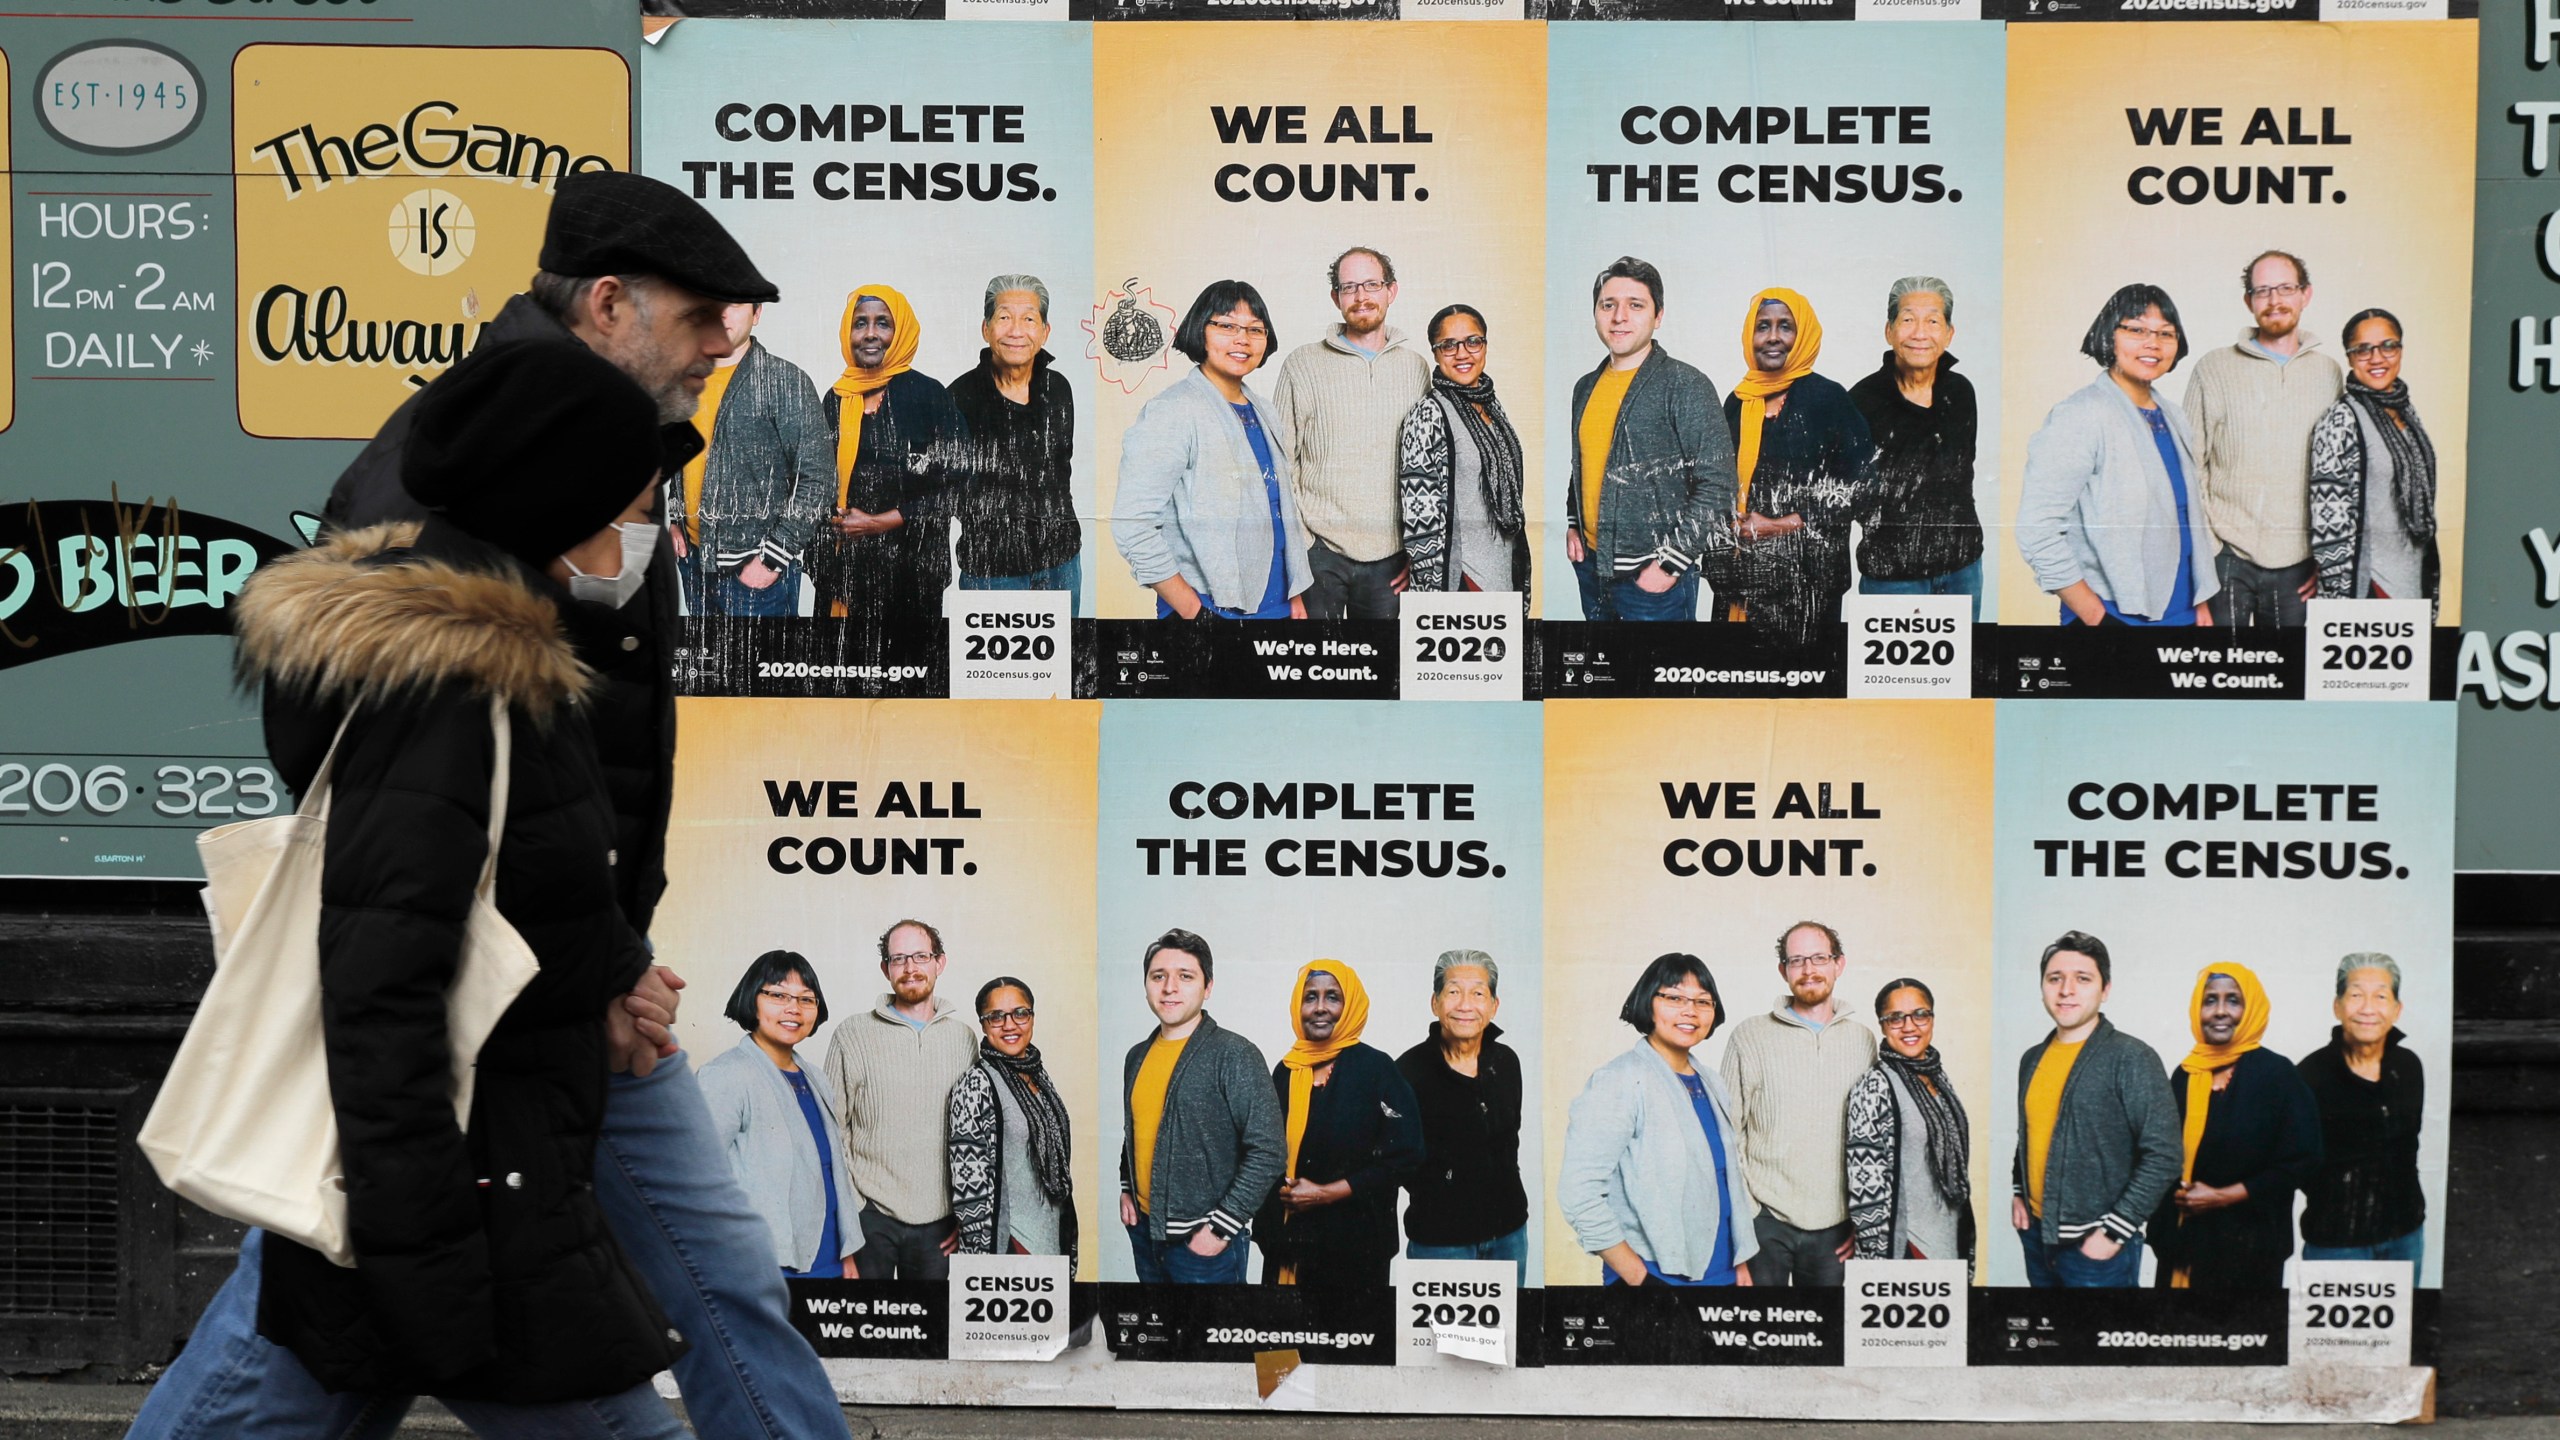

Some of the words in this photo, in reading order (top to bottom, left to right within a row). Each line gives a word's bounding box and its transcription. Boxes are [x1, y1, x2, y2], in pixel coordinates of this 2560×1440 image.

[2338, 0, 2426, 10] 2020census.gov
[715, 103, 1024, 142] COMPLETE
[1210, 106, 1306, 143] WE
[1324, 106, 1432, 143] ALL
[1621, 106, 1930, 144] COMPLETE
[2126, 108, 2222, 145] WE
[2241, 107, 2351, 145] ALL
[682, 161, 794, 199] THE
[813, 162, 1056, 201] CENSUS.
[1215, 164, 1428, 202] COUNT.
[1587, 165, 1698, 202] THE
[1718, 164, 1962, 203] CENSUS.
[2128, 166, 2346, 205] COUNT.
[41, 202, 208, 240] HOURS:
[58, 533, 258, 613] BEER
[966, 613, 1055, 628] CENSUS
[1416, 615, 1506, 630] CENSUS
[1865, 618, 1955, 633] CENSUS
[2324, 623, 2413, 637] CENSUS
[965, 635, 1054, 660] 2020
[1254, 640, 1316, 655] We’re
[1322, 640, 1378, 656] Here.
[1416, 637, 1506, 662] 2020
[1864, 640, 1954, 665] 2020
[2157, 647, 2221, 663] We’re
[2227, 648, 2284, 663] Here.
[2323, 645, 2412, 670] 2020
[758, 661, 928, 685] 2020census.gov
[967, 671, 1051, 680] 2020census.gov
[1267, 666, 1302, 680] We
[1308, 665, 1377, 680] Count.
[1417, 673, 1502, 682] 2020census.gov
[1655, 667, 1825, 686] 2020census.gov
[1865, 676, 1951, 685] 2020census.gov
[2171, 673, 2207, 688] We
[2211, 672, 2284, 688] Count.
[2323, 680, 2409, 690] 2020census.gov
[763, 781, 858, 817] WE
[875, 782, 981, 818] ALL
[1170, 782, 1474, 820] COMPLETE
[1660, 782, 1755, 819] WE
[1772, 782, 1880, 819] ALL
[2068, 782, 2377, 821] COMPLETE
[768, 837, 977, 875] COUNT.
[1137, 839, 1246, 875] THE
[1265, 839, 1506, 878] CENSUS.
[1663, 839, 1876, 876] COUNT.
[2034, 840, 2145, 877] THE
[2165, 840, 2409, 879] CENSUS.
[966, 1277, 1053, 1292] CENSUS
[1413, 1282, 1501, 1297] CENSUS
[1862, 1283, 1950, 1297] CENSUS
[2309, 1284, 2395, 1297] CENSUS
[807, 1299, 867, 1314] We’re
[874, 1300, 927, 1315] Here.
[965, 1298, 1053, 1323] 2020
[1411, 1303, 1501, 1329] 2020
[1699, 1306, 1761, 1322] We’re
[1768, 1308, 1822, 1322] Here.
[1861, 1304, 1950, 1328] 2020
[2307, 1305, 2394, 1328] 2020
[820, 1323, 854, 1338] We
[860, 1324, 927, 1339] Count.
[966, 1332, 1049, 1342] 2020census.gov
[1207, 1328, 1374, 1348] 2020census.gov
[1712, 1331, 1747, 1346] We
[1753, 1331, 1822, 1346] Count.
[2098, 1332, 2267, 1350] 2020census.gov
[1862, 1338, 1947, 1348] 2020census.gov
